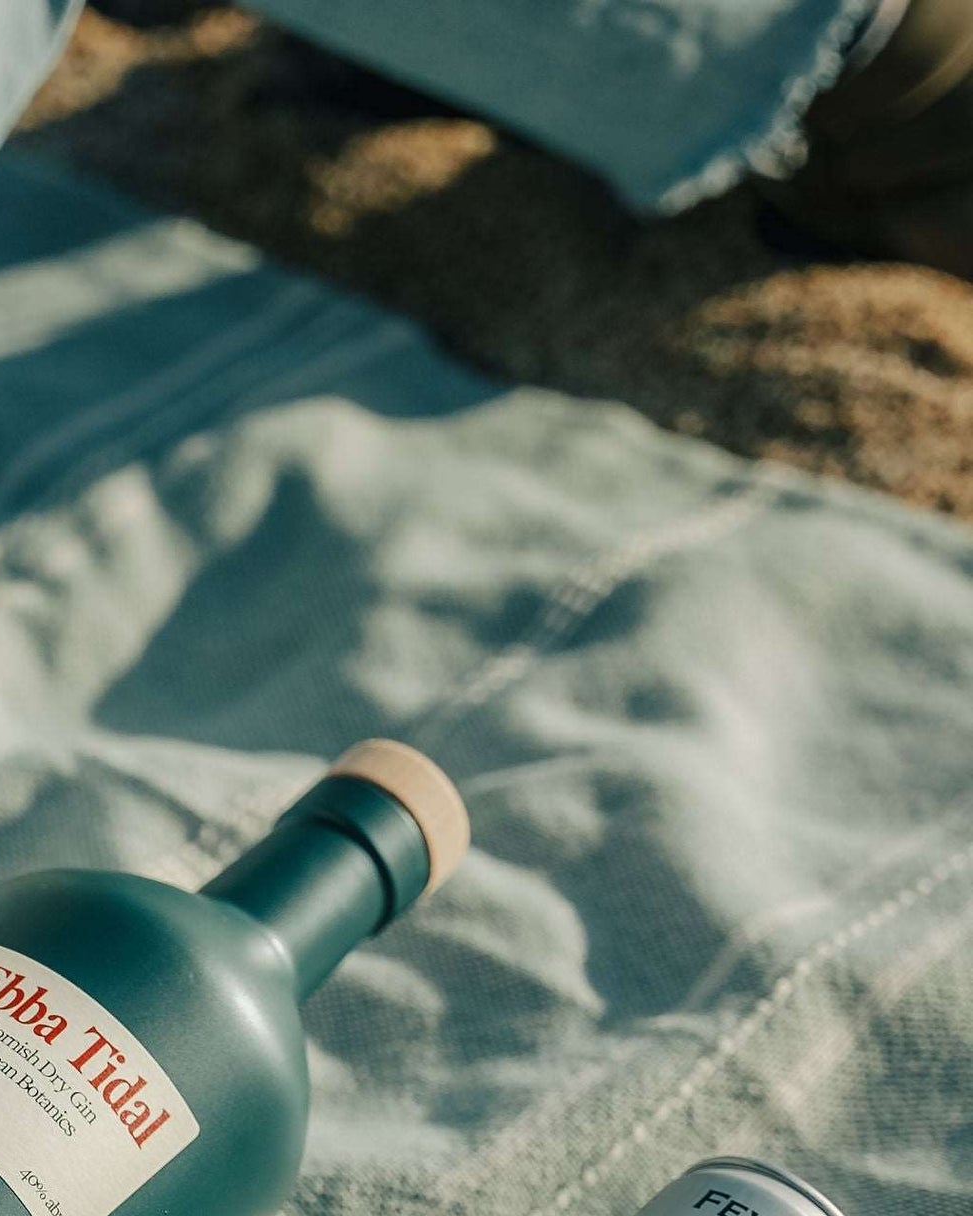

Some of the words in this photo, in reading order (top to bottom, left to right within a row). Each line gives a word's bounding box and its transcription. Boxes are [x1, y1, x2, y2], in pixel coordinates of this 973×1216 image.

[15, 1074, 76, 1137] Botanics
[37, 1060, 71, 1095] Dry
[70, 1091, 97, 1125] Gin
[67, 1026, 170, 1149] Tidal
[18, 1168, 47, 1200] 40%
